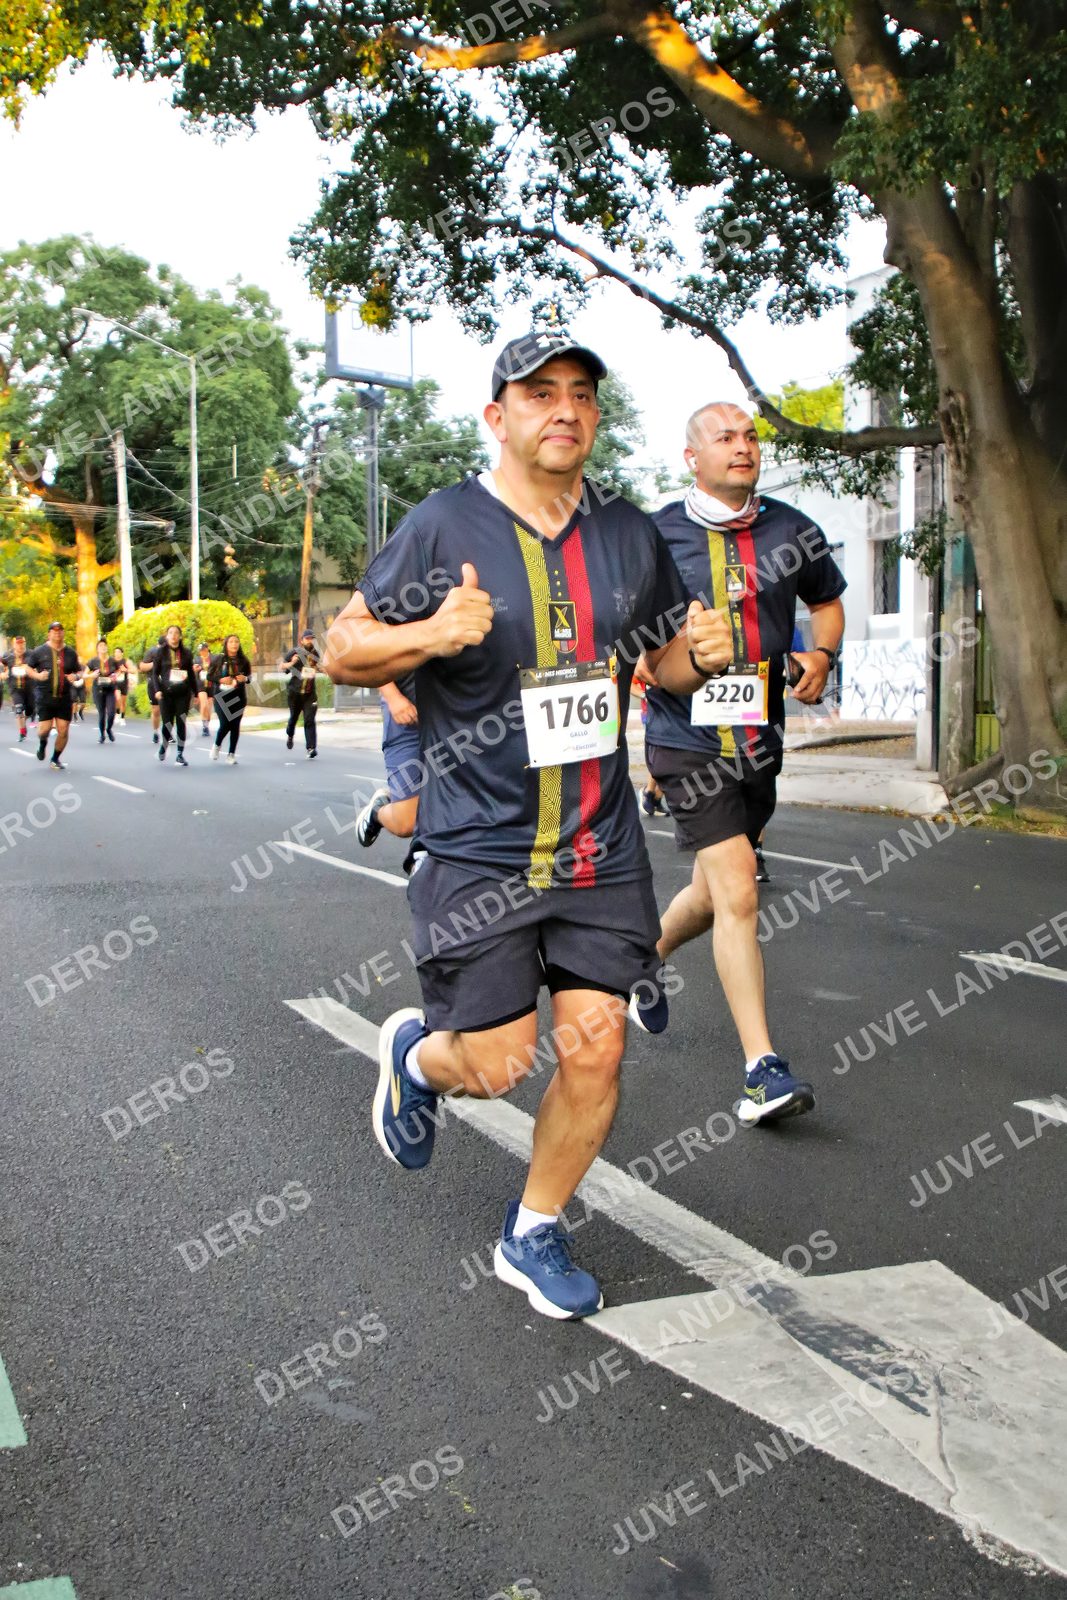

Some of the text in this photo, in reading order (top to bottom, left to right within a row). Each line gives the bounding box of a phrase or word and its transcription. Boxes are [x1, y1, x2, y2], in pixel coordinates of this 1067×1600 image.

[703, 683, 755, 703] 5220
[539, 691, 609, 730] 1766
[570, 730, 588, 738] GALLO
